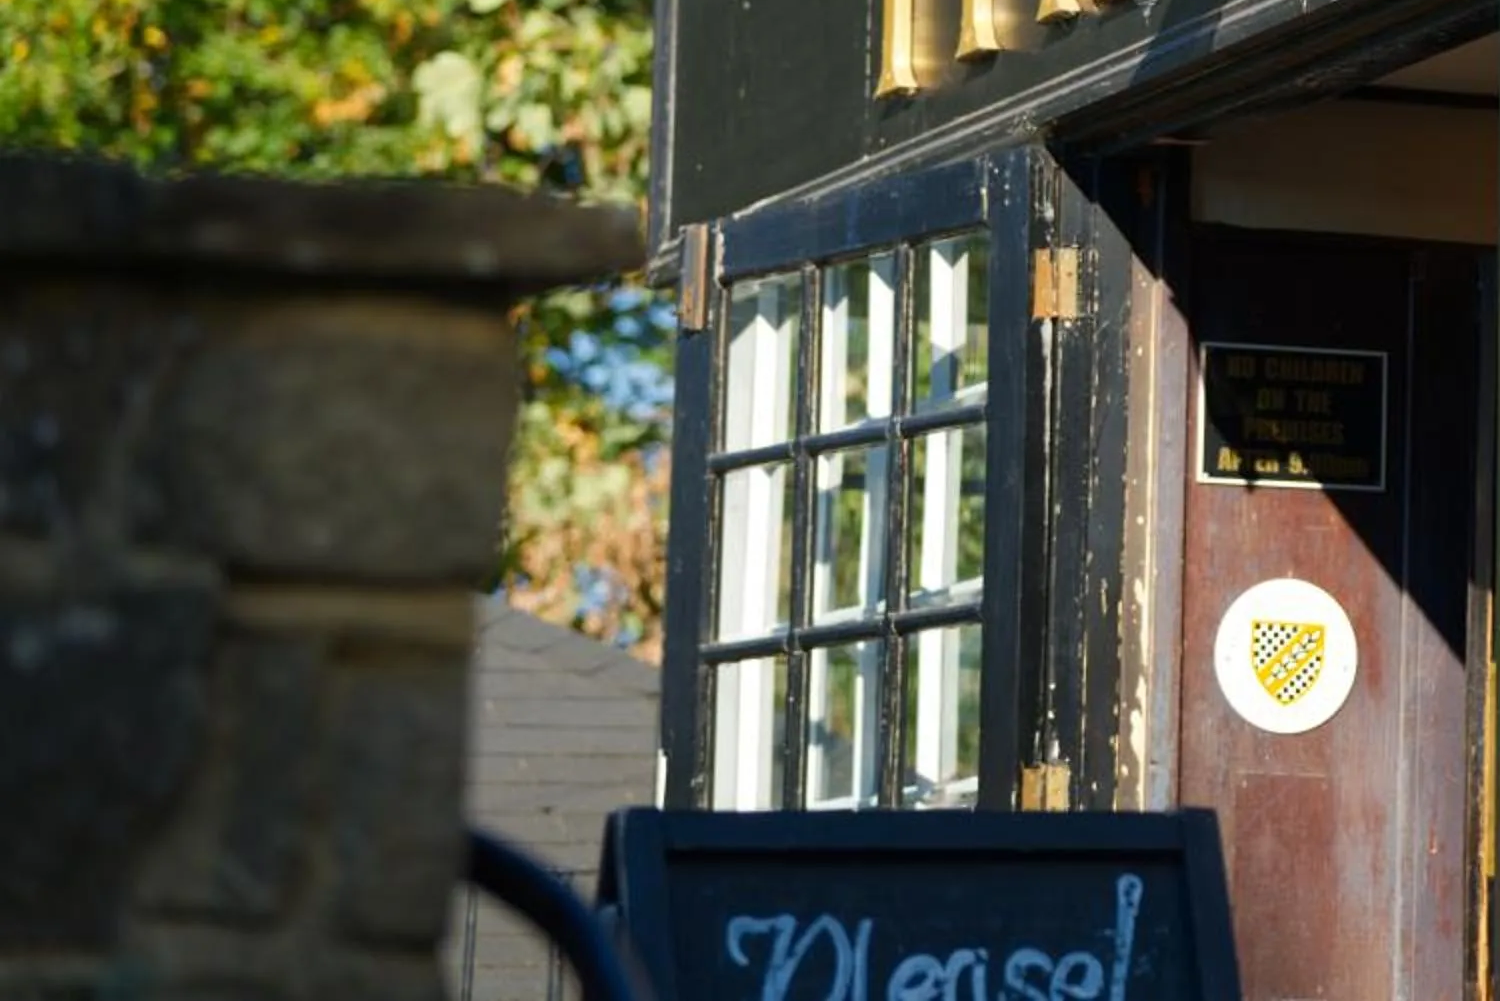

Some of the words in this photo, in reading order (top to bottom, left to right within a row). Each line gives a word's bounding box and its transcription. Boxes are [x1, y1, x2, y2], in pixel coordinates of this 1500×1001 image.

[1264, 356, 1365, 385] CHILDREN
[1256, 387, 1286, 411] ON
[1292, 388, 1333, 416] THE
